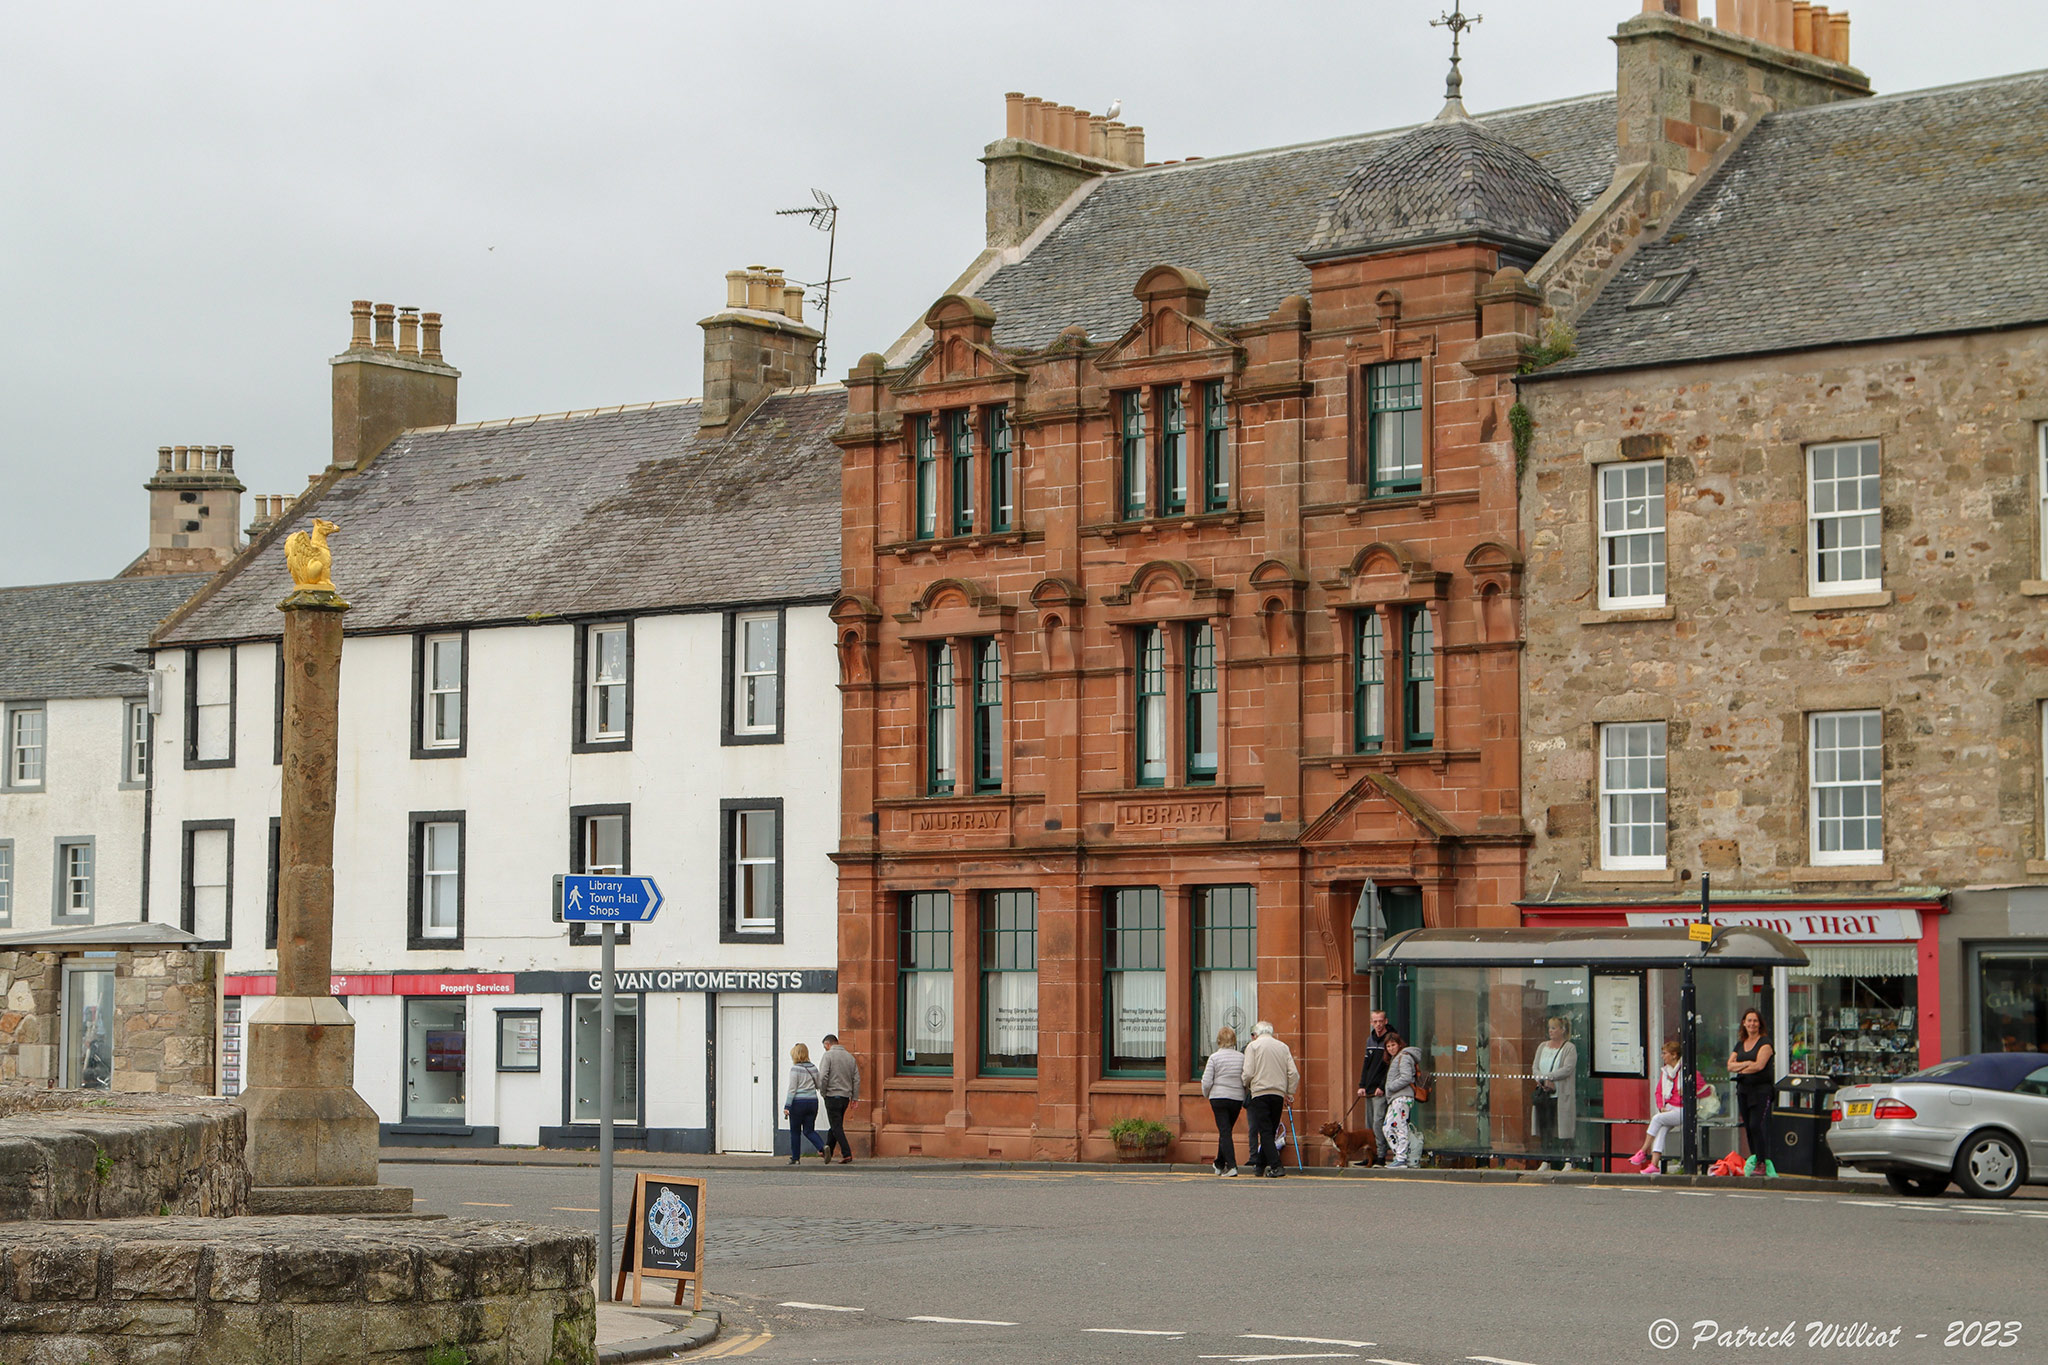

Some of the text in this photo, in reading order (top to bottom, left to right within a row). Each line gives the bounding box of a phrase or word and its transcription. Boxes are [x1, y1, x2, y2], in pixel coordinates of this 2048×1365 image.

[920, 803, 1219, 831] MURRAY LIBRARY
[589, 880, 623, 893] Library
[589, 892, 639, 904] Town Hall
[589, 905, 620, 917] Shops
[588, 971, 803, 991] GVAN OPTOMETRISTS
[440, 983, 510, 994] Property Services
[647, 1245, 688, 1262] This Way
